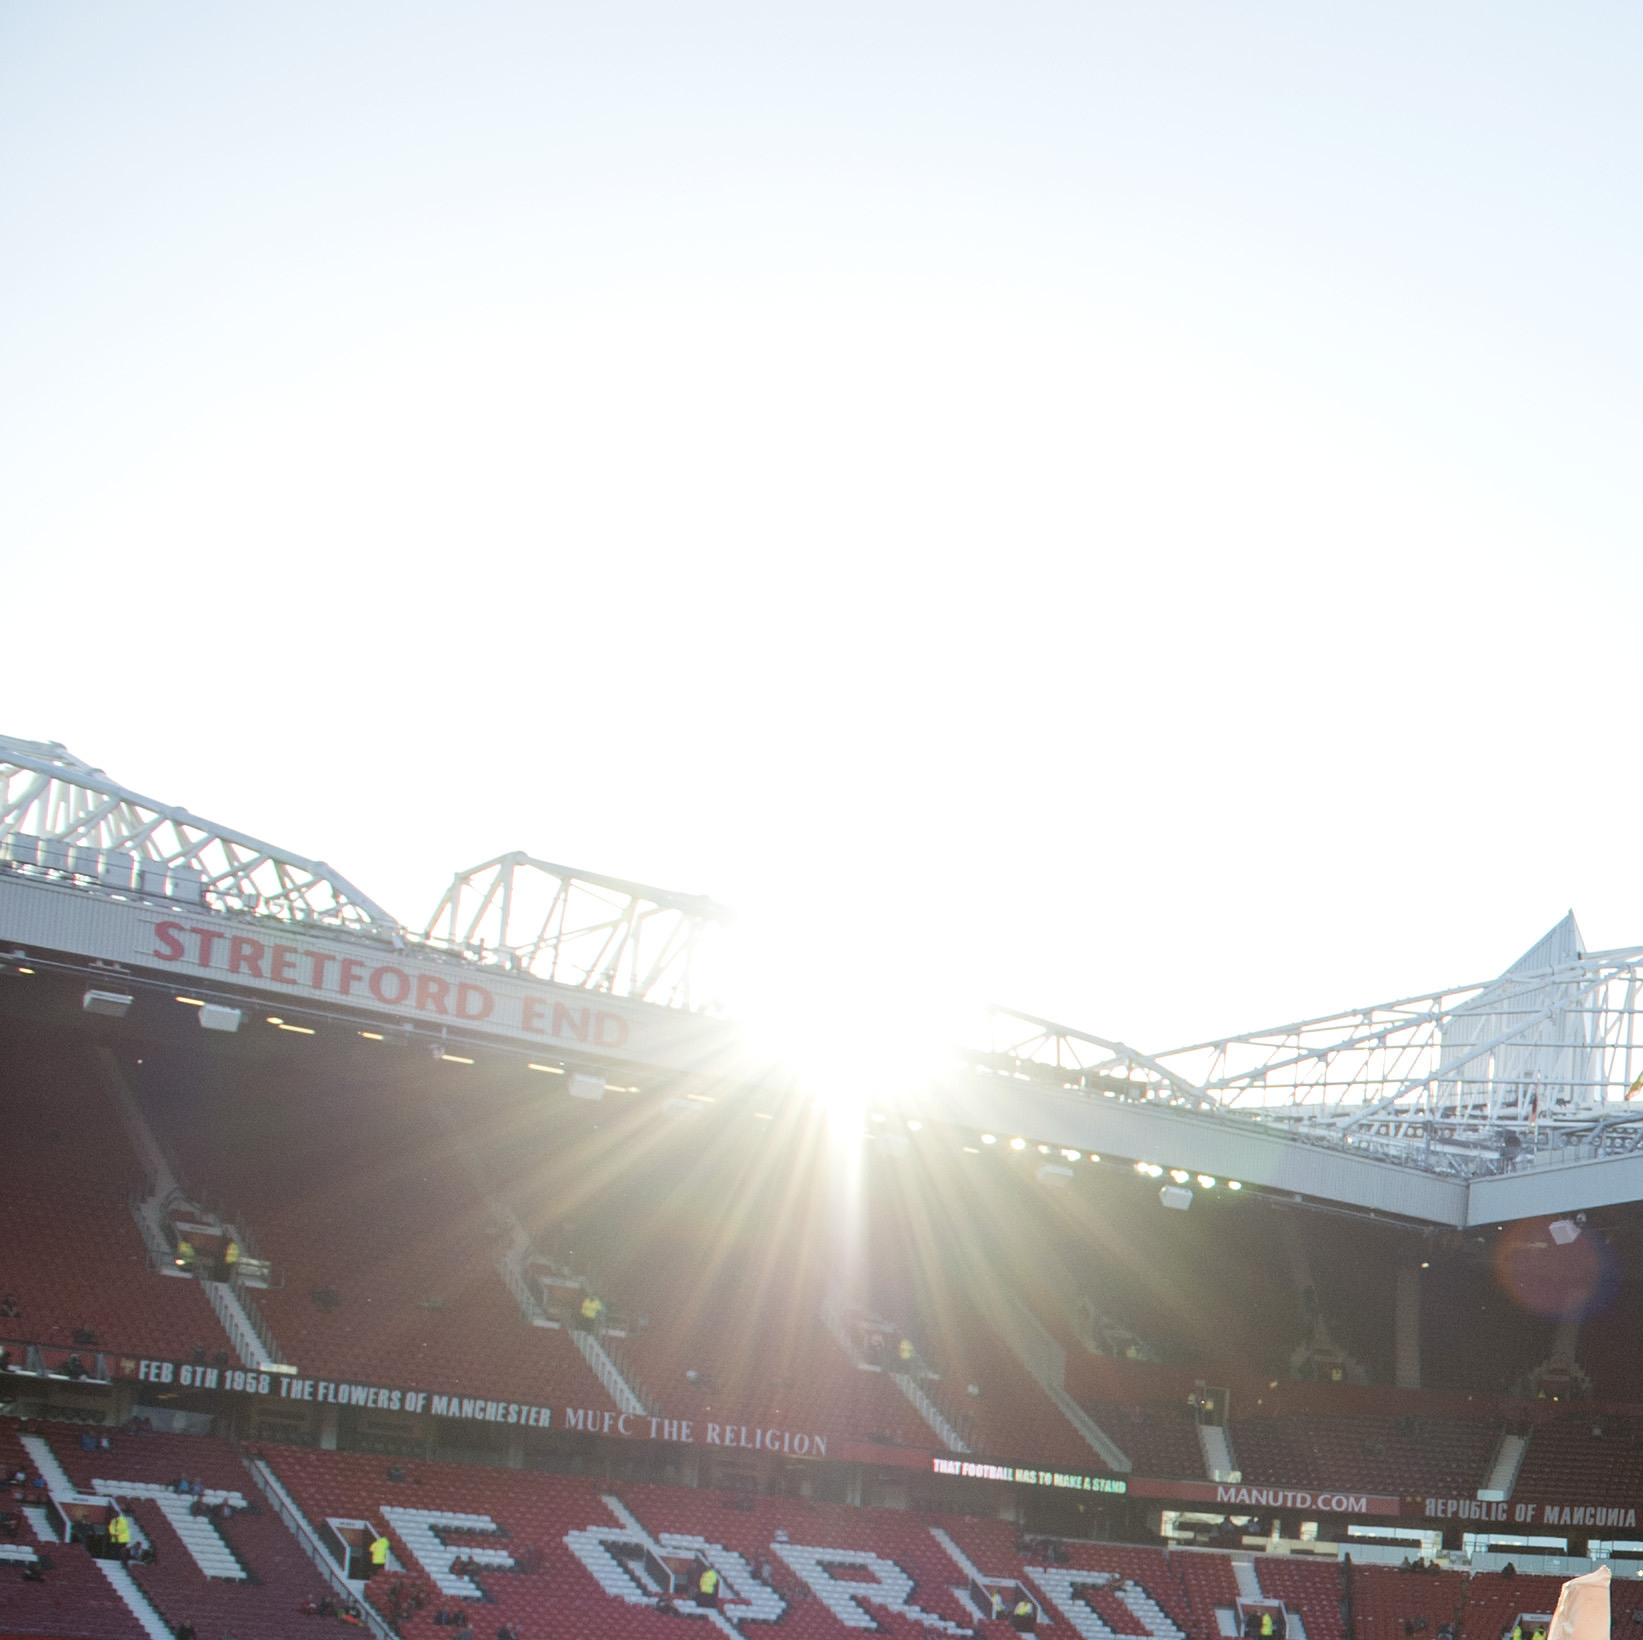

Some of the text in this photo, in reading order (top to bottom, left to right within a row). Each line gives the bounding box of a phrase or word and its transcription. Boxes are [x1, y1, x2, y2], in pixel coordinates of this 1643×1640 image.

[153, 921, 630, 1048] STRETFORD END
[138, 1360, 552, 1428] FEB 6TH 1958 THE FLOWERS OF MANCHESTER
[565, 1407, 828, 1456] MUFC THE RELIGION
[932, 1458, 1127, 1495] THAT FOOTBALL HAS TO MAKE A STAND
[1216, 1485, 1367, 1514] MANUTD.COM
[1514, 1503, 1538, 1523] OF
